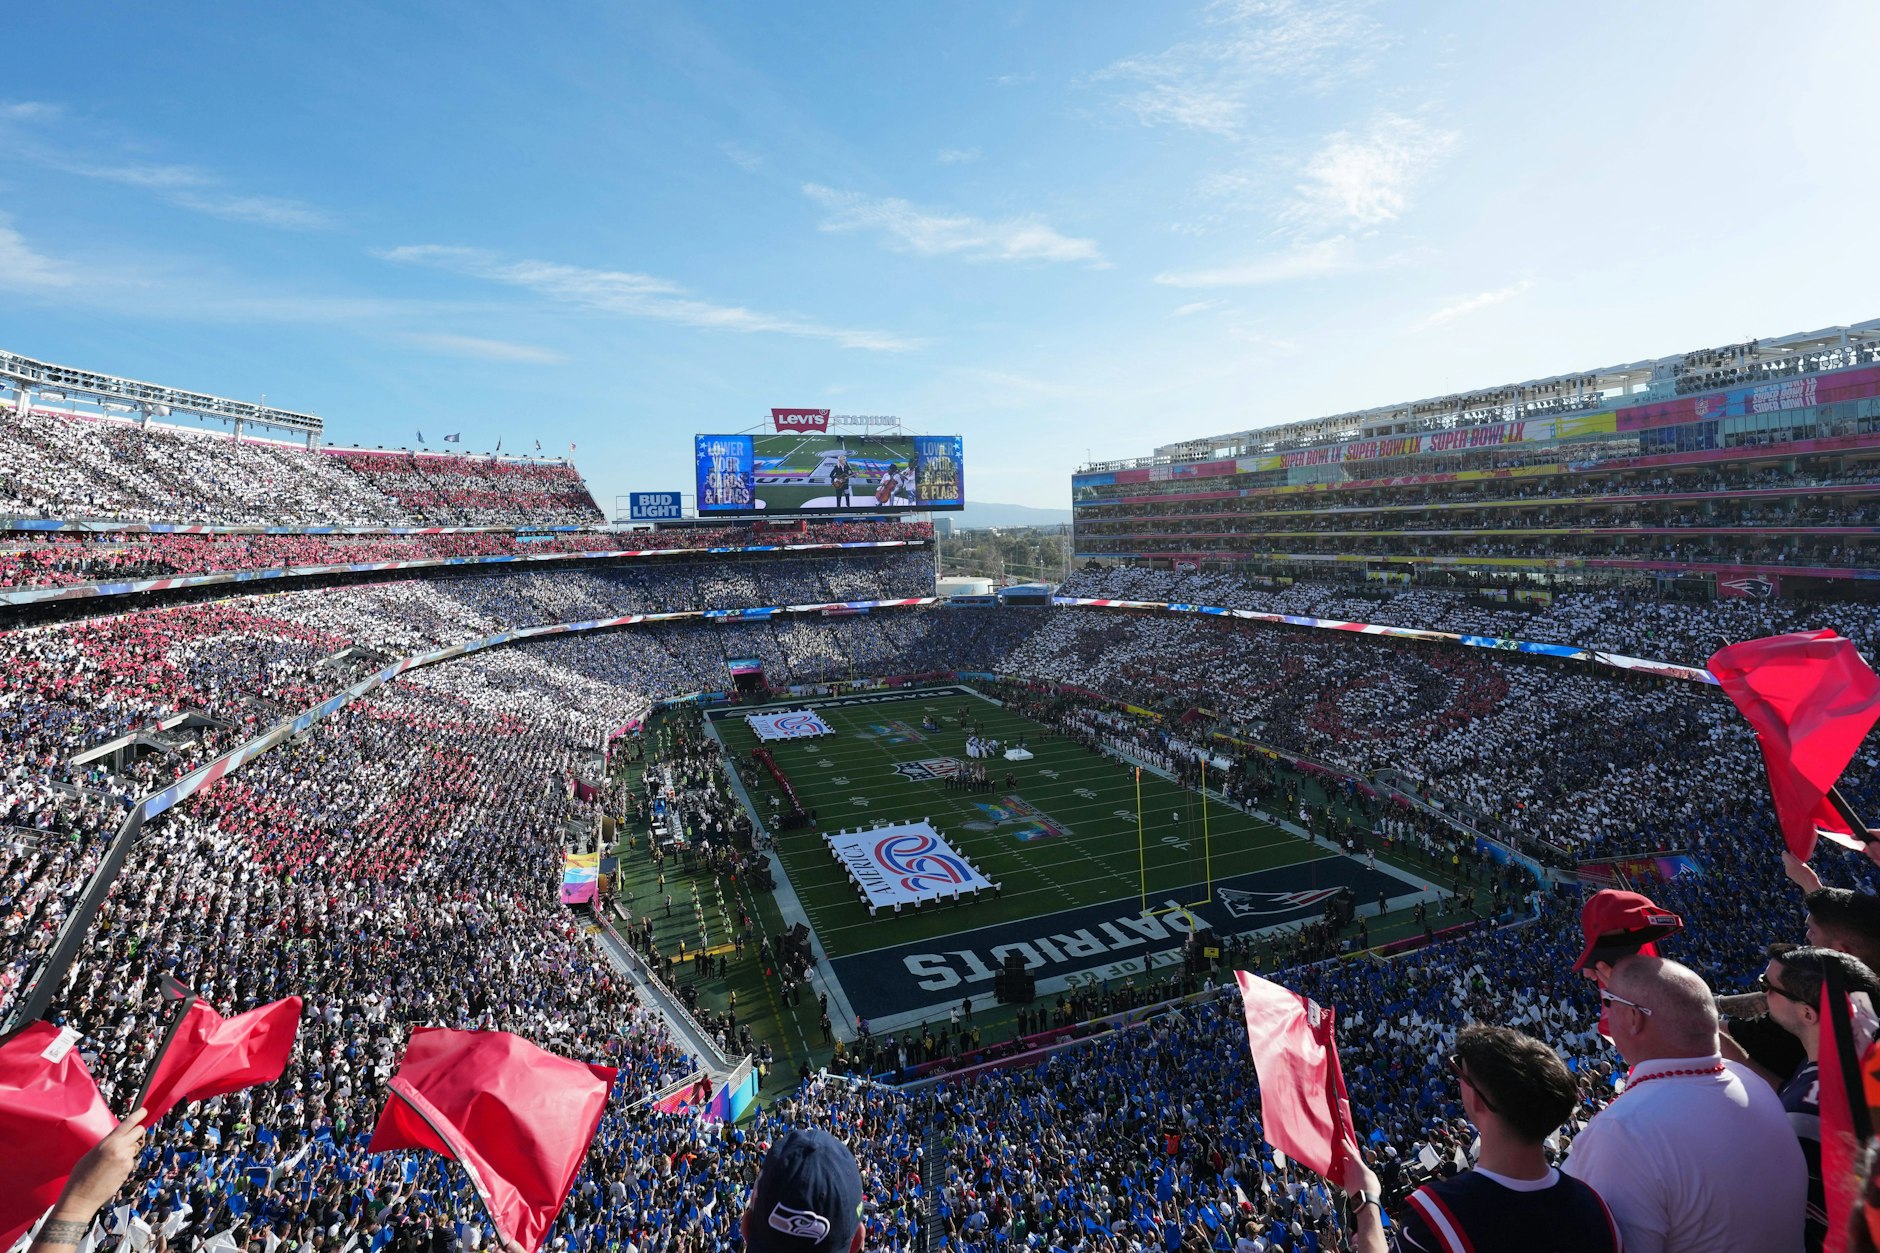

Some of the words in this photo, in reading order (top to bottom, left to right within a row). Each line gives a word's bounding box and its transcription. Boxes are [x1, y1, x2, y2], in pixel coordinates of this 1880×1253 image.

[834, 415, 896, 426] STADIUM
[1430, 429, 1469, 451] SUPER
[1470, 424, 1505, 447] BOWL
[1508, 422, 1526, 442] LX
[707, 441, 744, 456] LOWER
[923, 442, 954, 456] LOWER
[1347, 442, 1377, 460] SUPER
[1379, 438, 1407, 457] BOWL
[1409, 437, 1422, 454] LX
[712, 456, 740, 472] YOUR
[927, 456, 951, 470] YOUR
[1280, 452, 1305, 469] SUPER
[1306, 449, 1329, 465] BOWL
[1331, 446, 1341, 463] LX
[708, 472, 746, 489] CARDS
[639, 494, 672, 506] BUD
[705, 489, 714, 504] &
[714, 488, 750, 504] FLAGS
[921, 485, 929, 499] &
[931, 485, 959, 499] FLAGS
[632, 505, 679, 517] LIGHT
[840, 843, 896, 895] AMERICA
[902, 899, 1214, 992] PATRIOTS
[1111, 961, 1139, 978] OF
[1063, 971, 1099, 987] US
